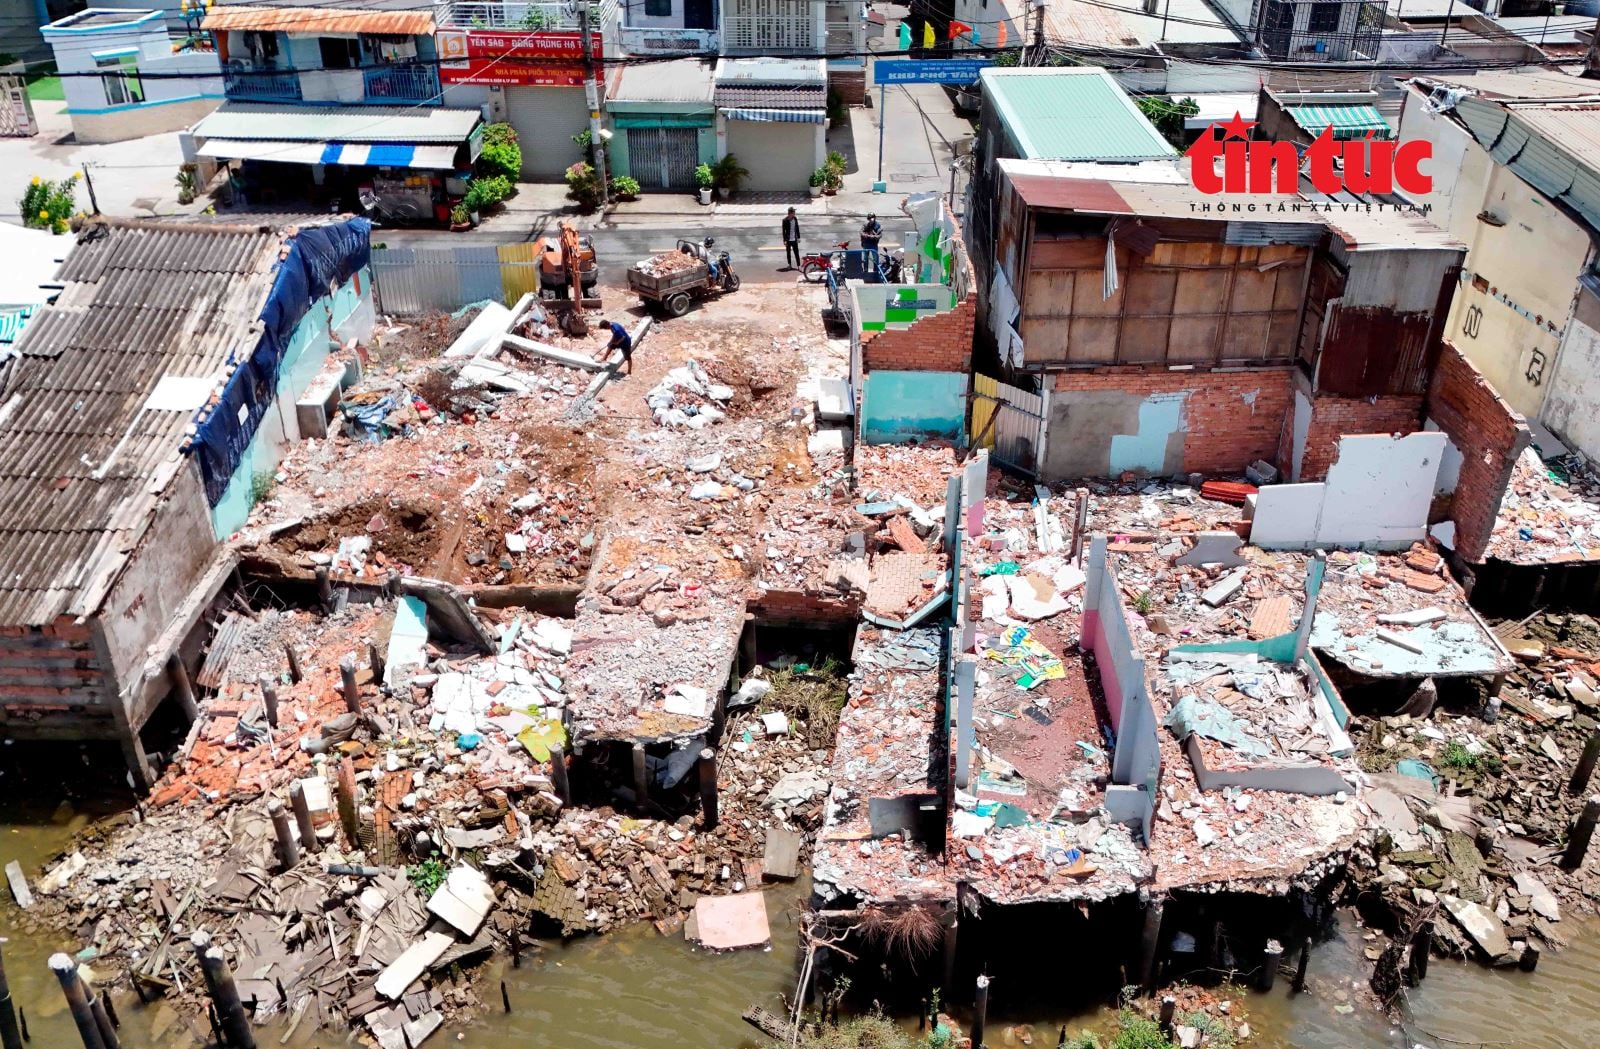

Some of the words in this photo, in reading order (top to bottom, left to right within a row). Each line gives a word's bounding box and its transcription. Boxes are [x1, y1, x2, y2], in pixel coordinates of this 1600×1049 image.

[563, 40, 576, 50] HẠ
[888, 72, 916, 80] KHU
[919, 70, 947, 79] PHỐ
